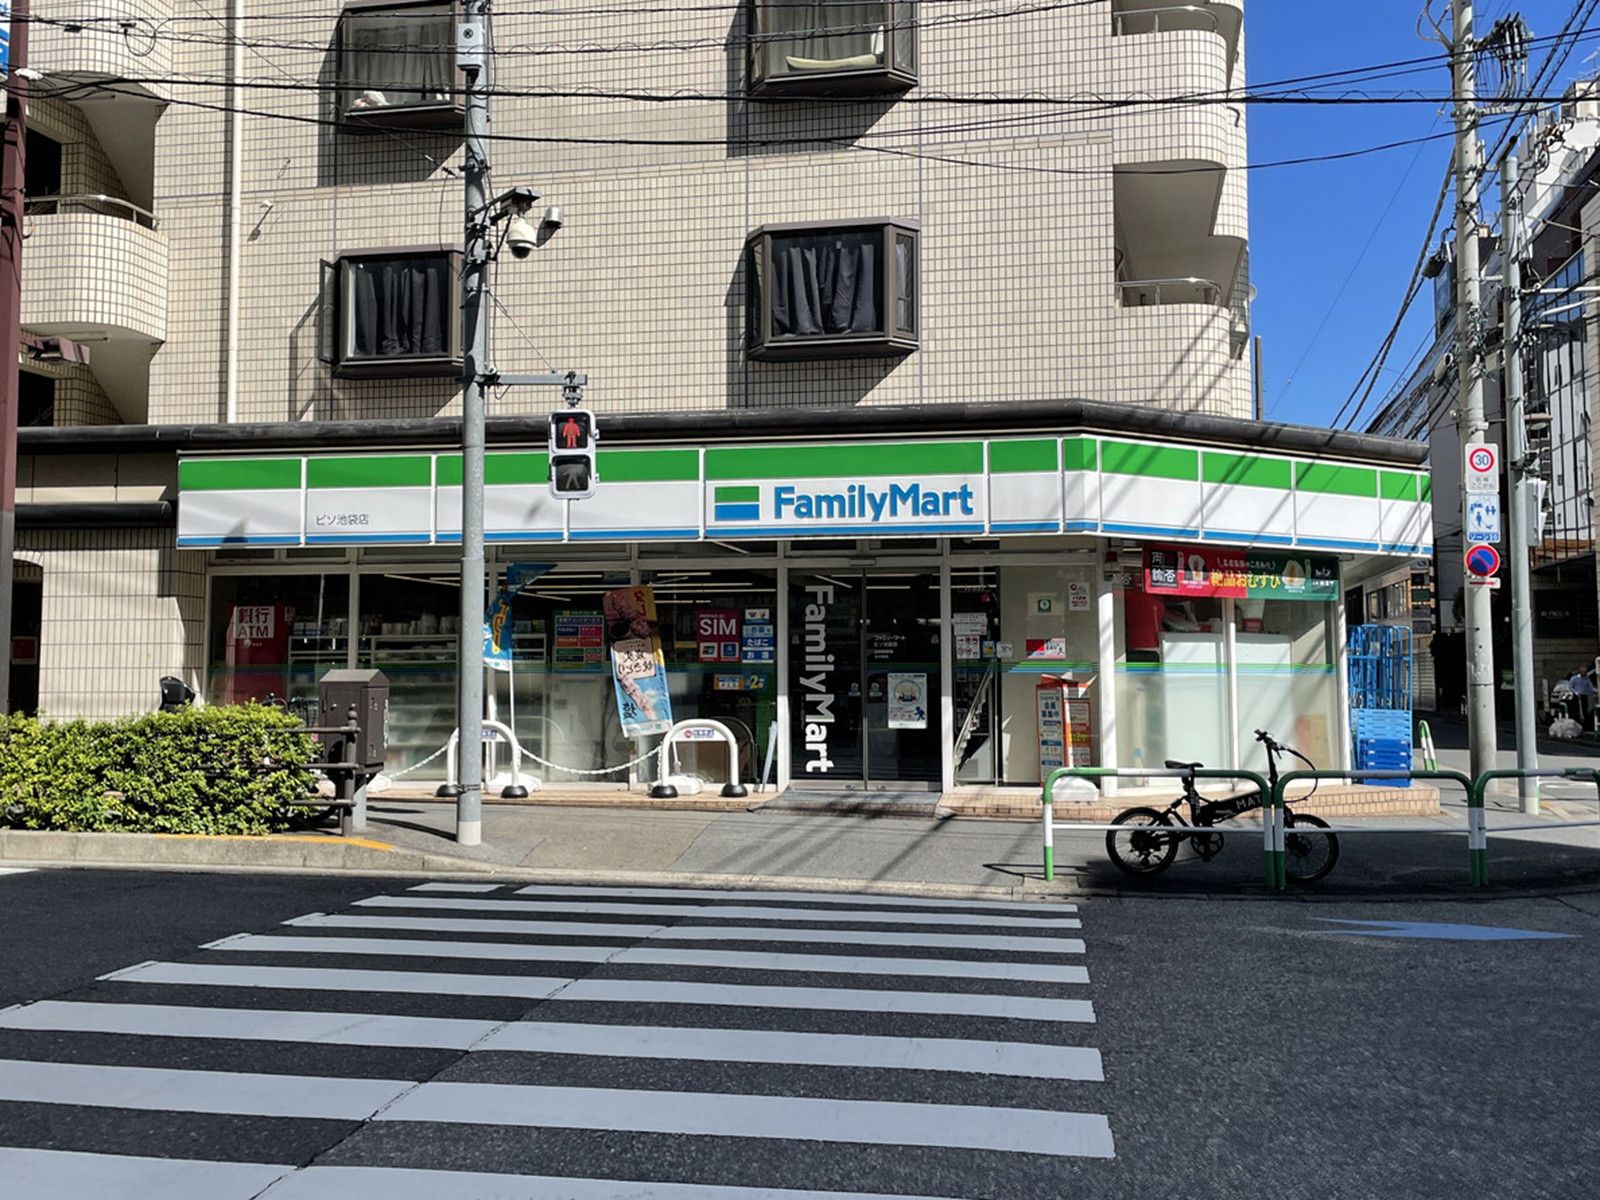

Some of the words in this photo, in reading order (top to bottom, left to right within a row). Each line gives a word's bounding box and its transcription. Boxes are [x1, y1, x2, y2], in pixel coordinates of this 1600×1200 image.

[1475, 455, 1489, 466] 30
[774, 483, 974, 522] FamilyMart
[1210, 569, 1281, 589] 絶品おむすび
[238, 607, 270, 624] 銀行
[237, 625, 269, 637] ATM
[699, 618, 737, 635] SIM
[747, 638, 769, 647] たばこ
[799, 585, 835, 773] FamilyMart
